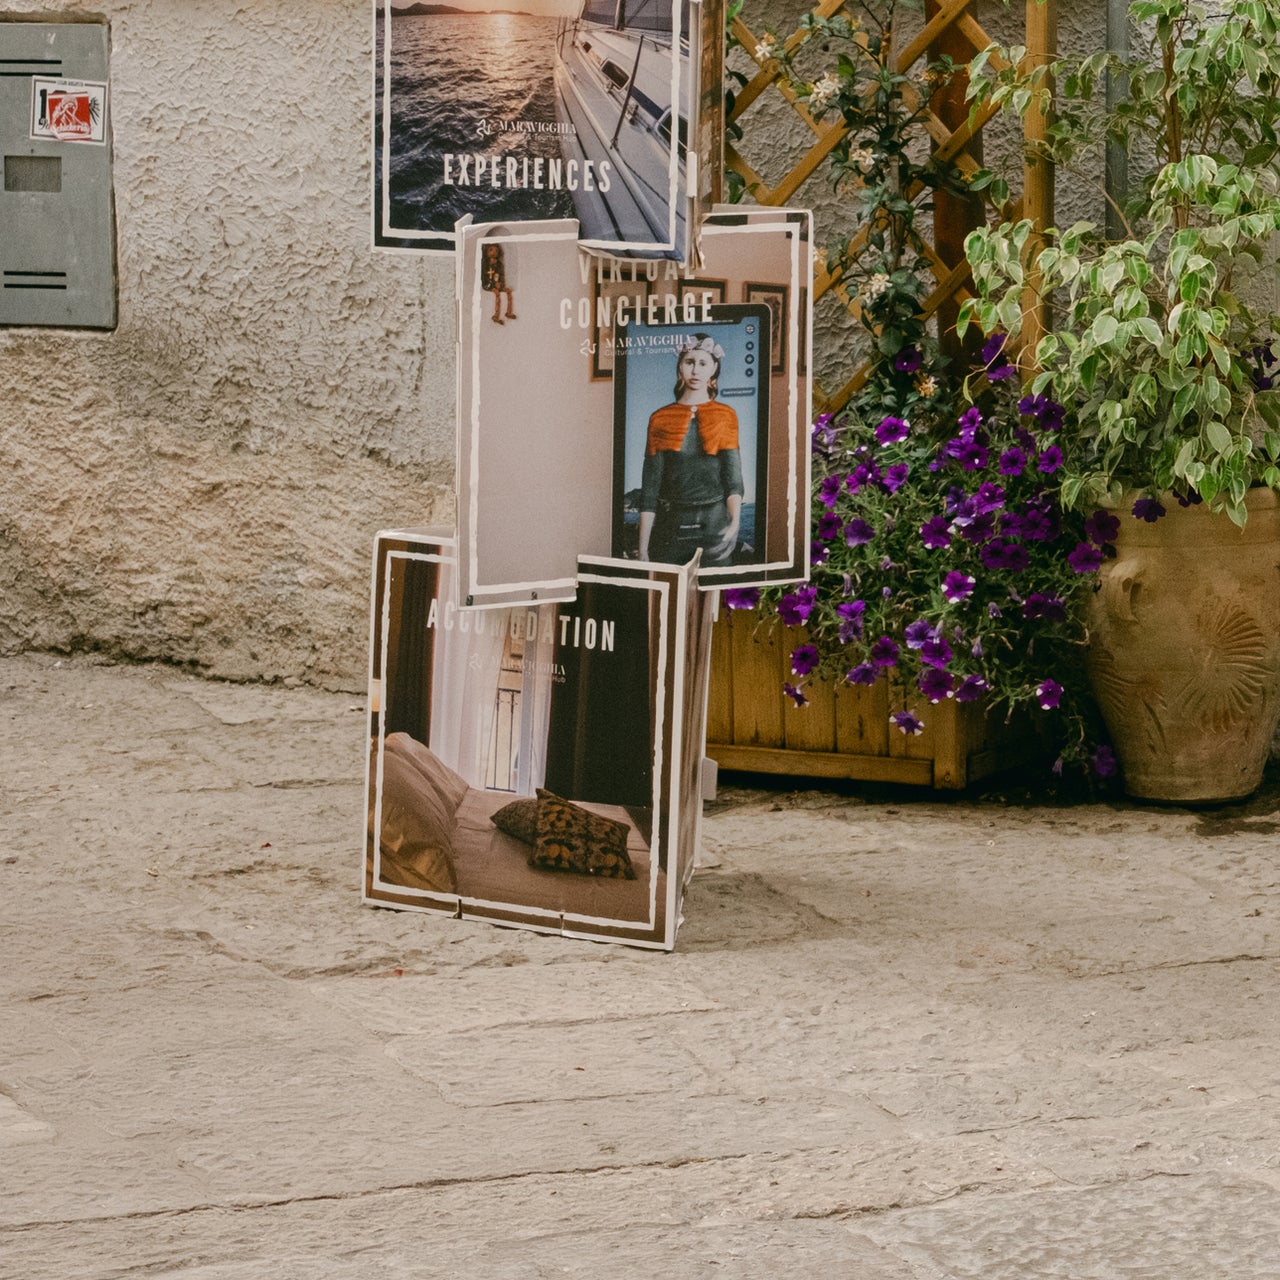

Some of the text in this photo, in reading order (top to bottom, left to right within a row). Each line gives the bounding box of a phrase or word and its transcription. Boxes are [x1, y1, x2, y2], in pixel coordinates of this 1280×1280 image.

[443, 153, 611, 193] EXPERIENCES
[560, 292, 713, 329] CONCIERGE
[426, 598, 615, 652] ACCOMODATION
